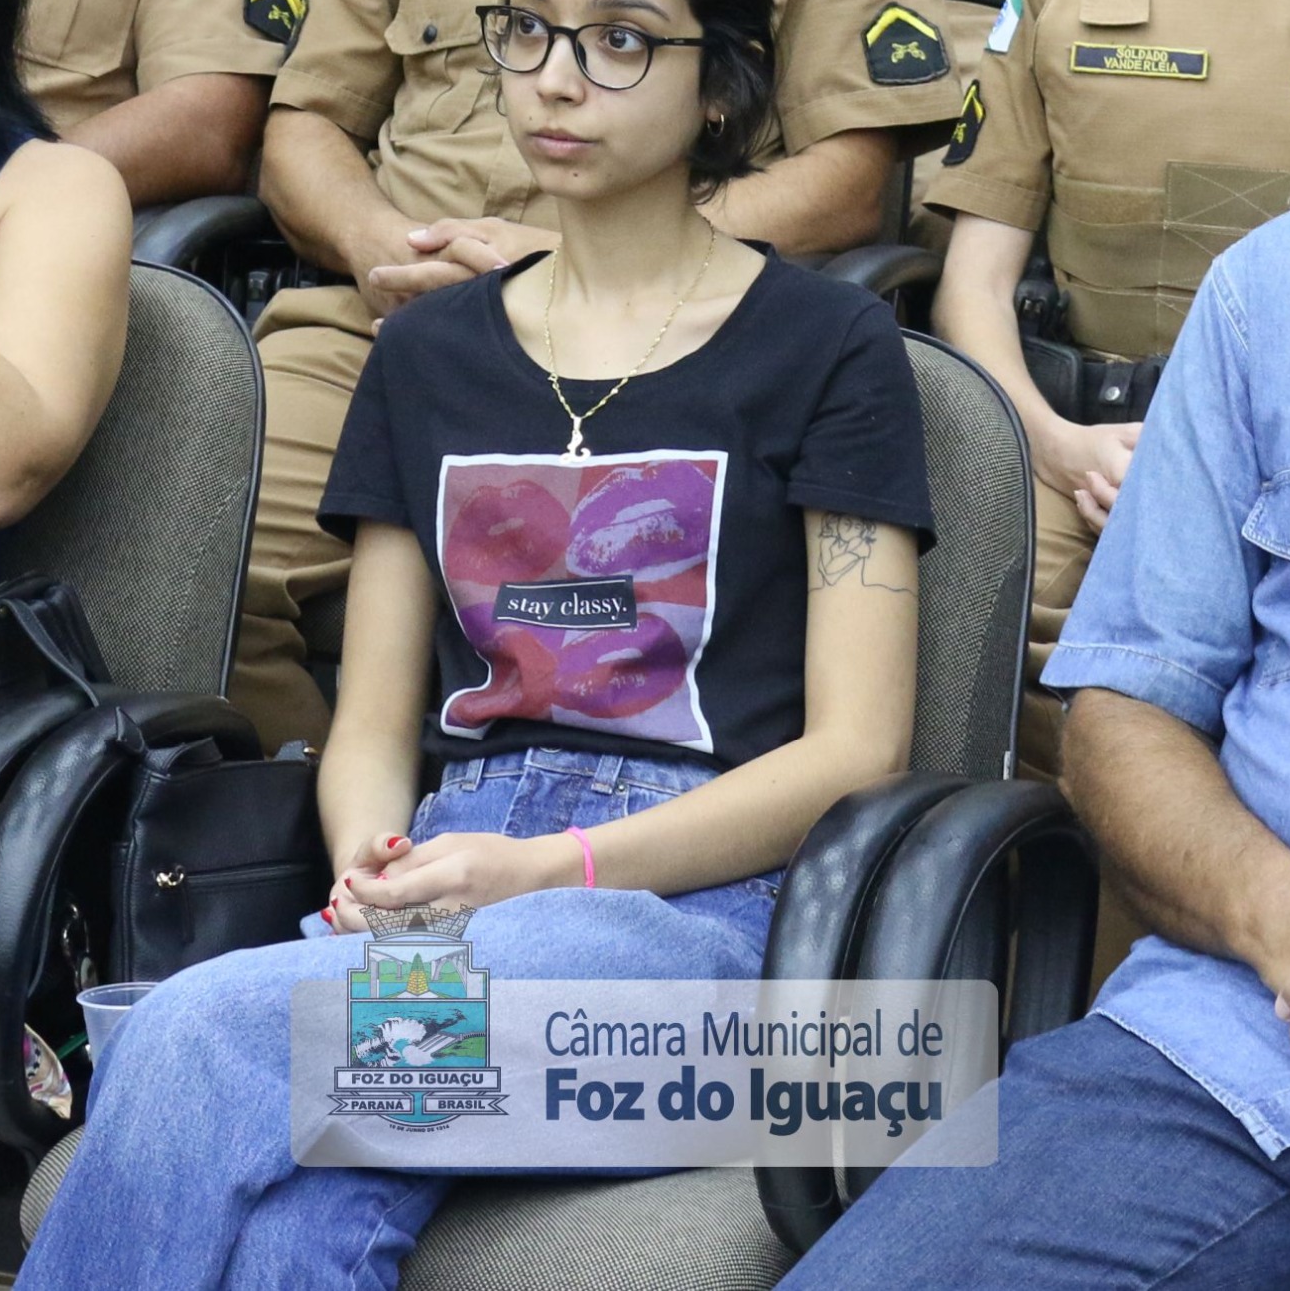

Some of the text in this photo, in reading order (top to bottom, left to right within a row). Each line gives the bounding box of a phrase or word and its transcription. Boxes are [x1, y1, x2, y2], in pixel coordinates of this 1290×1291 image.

[1115, 46, 1169, 62] SOLDADO
[1103, 56, 1179, 73] VANDERLEIA
[507, 591, 628, 621] stay classy.
